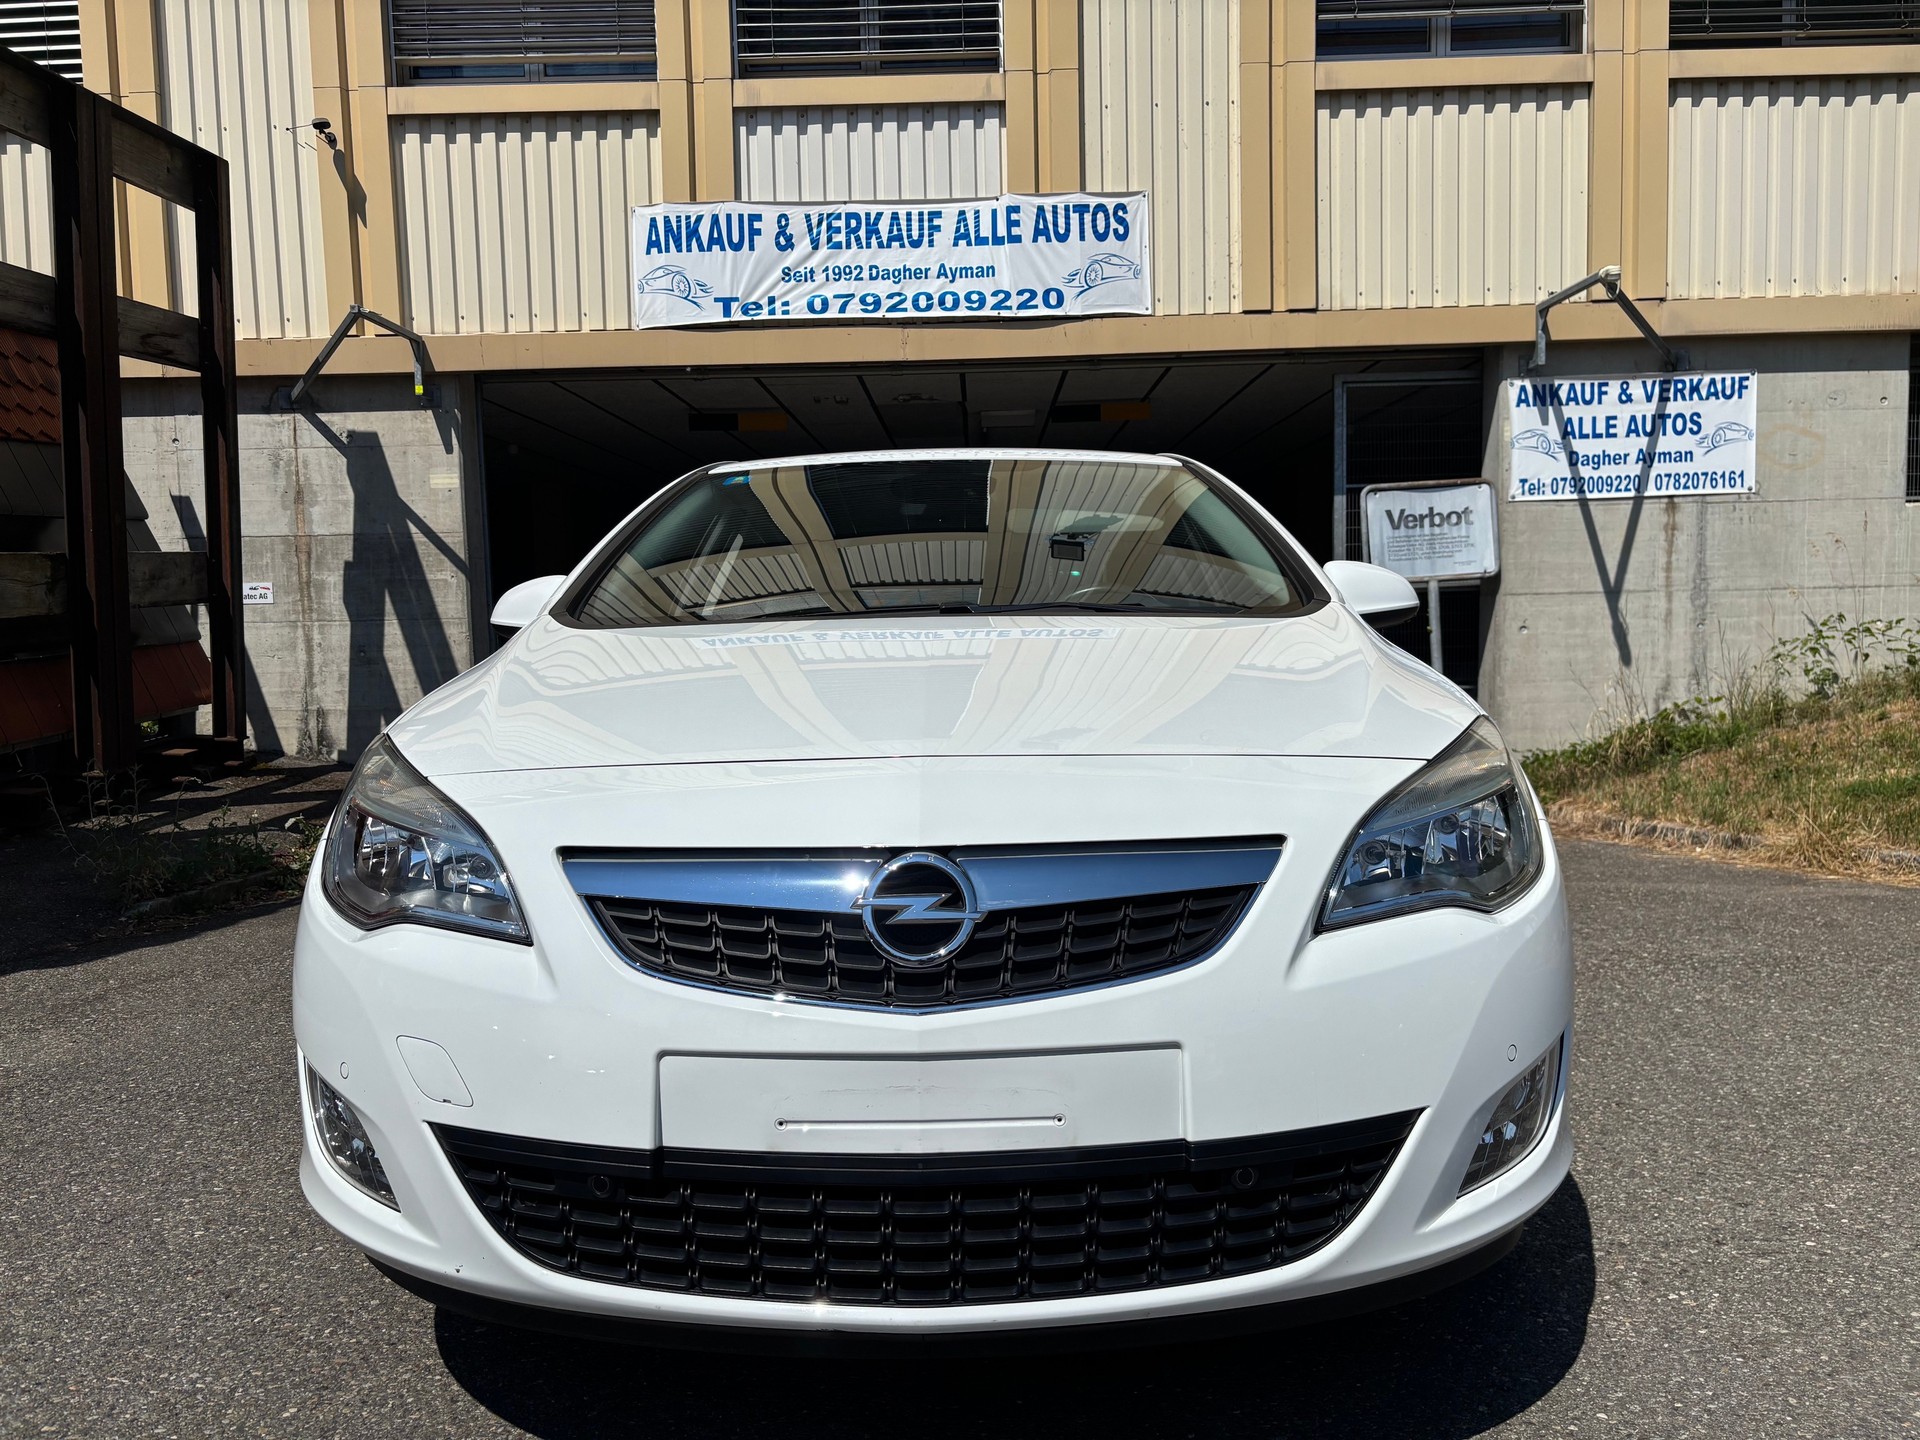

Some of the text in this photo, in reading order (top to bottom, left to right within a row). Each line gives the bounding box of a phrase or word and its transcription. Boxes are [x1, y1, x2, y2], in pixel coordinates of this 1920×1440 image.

[645, 202, 1131, 256] ANKAUF & VERKAUF ALLE AUTOS
[781, 262, 996, 285] Seit 1992 Dagher Ayman
[713, 287, 1065, 319] Tel: 0792009220
[1515, 376, 1750, 408] ANKAUF & VERKAUF
[1562, 411, 1703, 440] ALLE AUTOS
[1568, 449, 1694, 471] Dagher Ayman
[1519, 477, 1546, 496] Tel:
[1550, 474, 1642, 495] 0792009220
[1654, 469, 1745, 491] 0782076161
[1384, 505, 1474, 531] Verbot
[258, 592, 269, 600] AG
